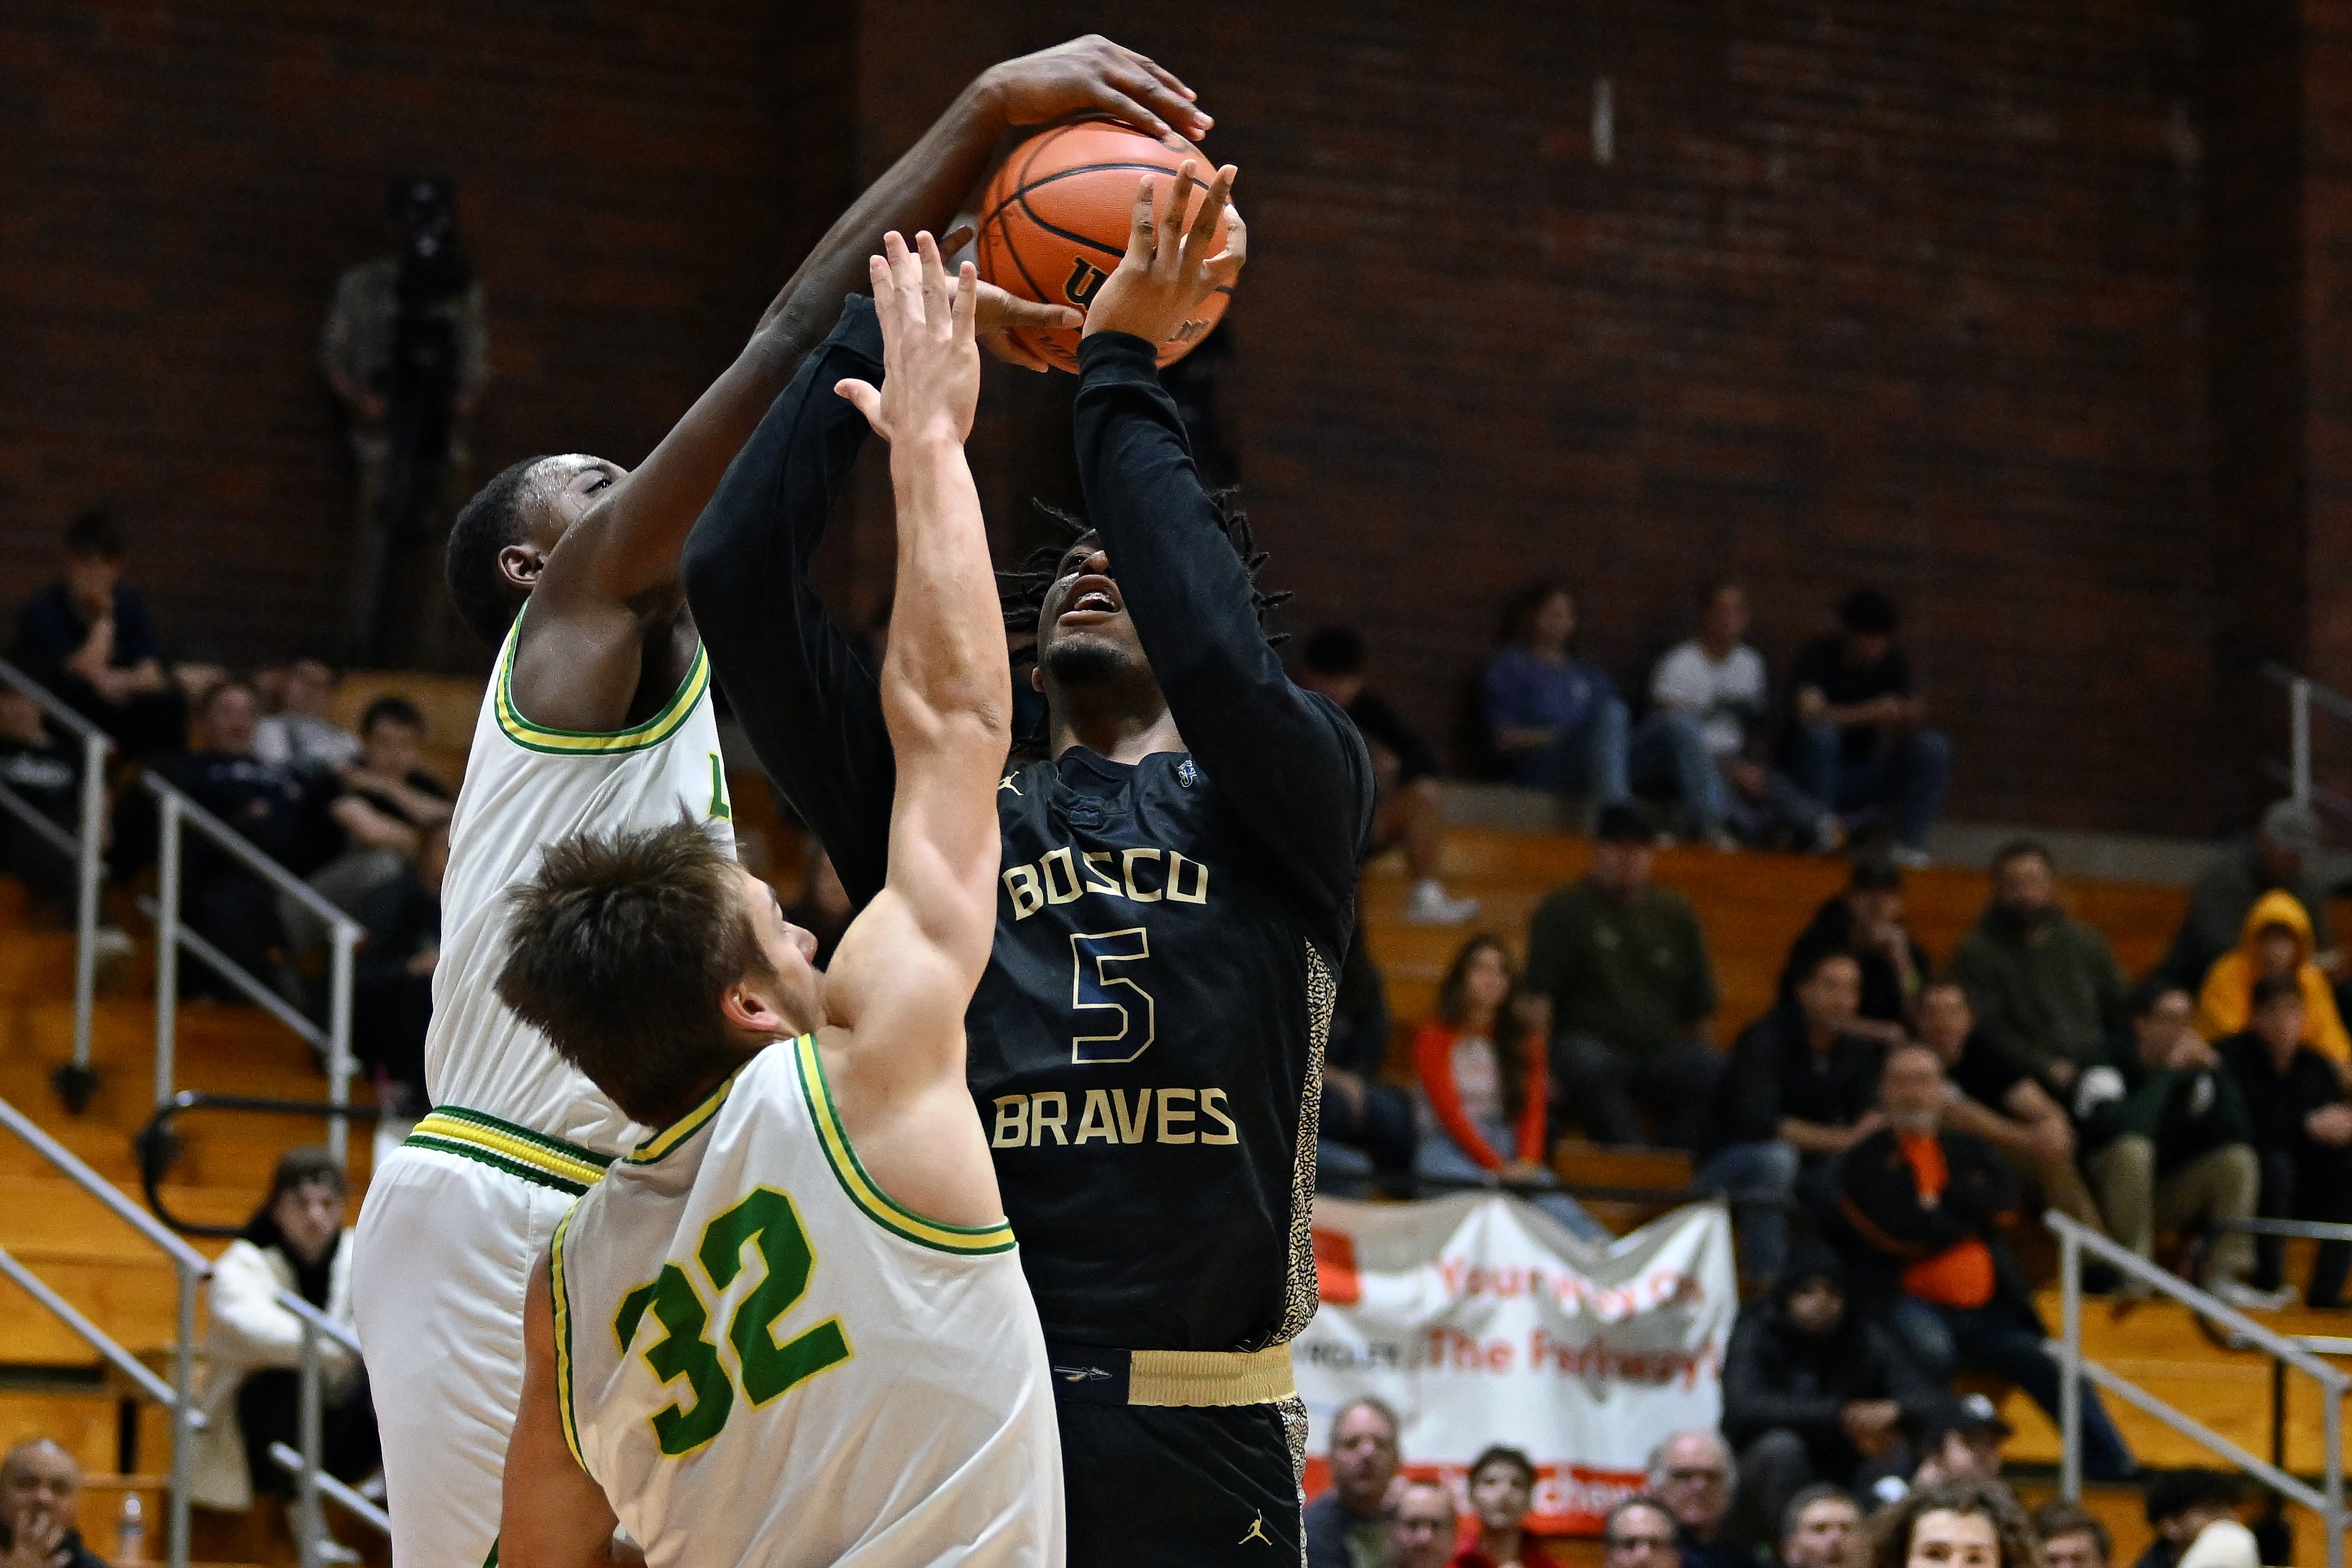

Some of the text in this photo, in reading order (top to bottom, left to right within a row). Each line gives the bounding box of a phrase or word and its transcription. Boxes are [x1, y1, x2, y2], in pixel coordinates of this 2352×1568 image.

[1001, 846, 1207, 921] BOSCO
[1070, 927, 1154, 1065] 5
[991, 1088, 1238, 1148] BRAVES
[612, 1183, 855, 1460] 32
[1426, 1324, 1515, 1370] The
